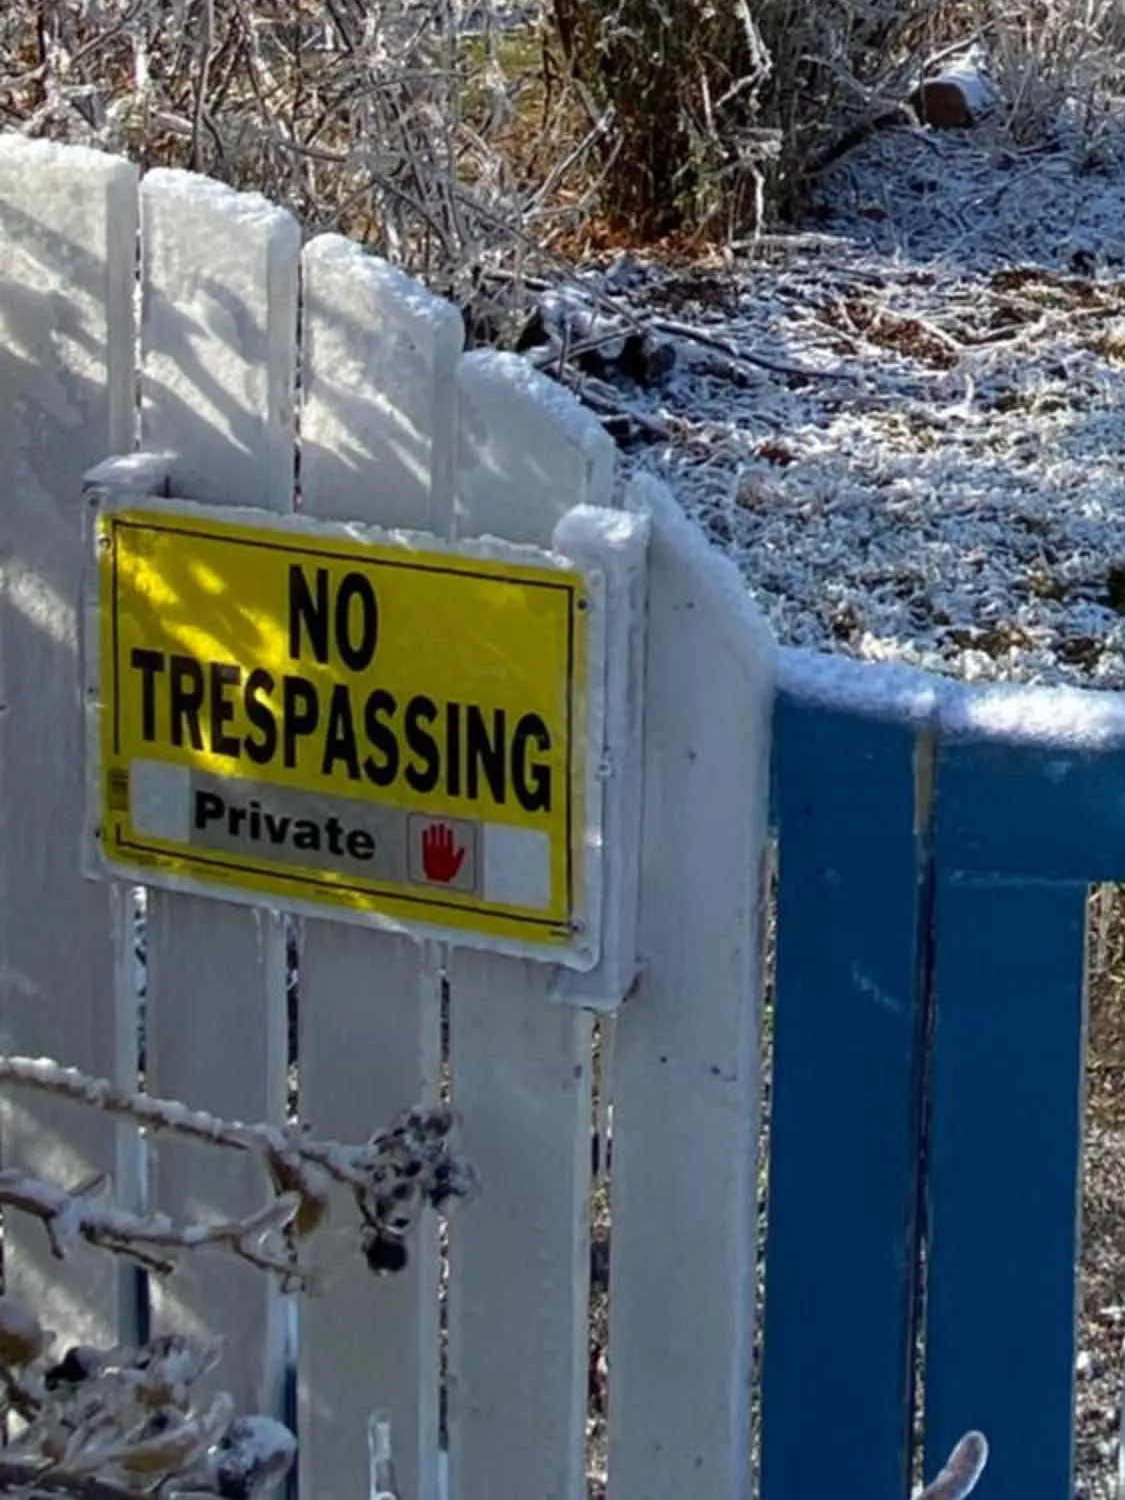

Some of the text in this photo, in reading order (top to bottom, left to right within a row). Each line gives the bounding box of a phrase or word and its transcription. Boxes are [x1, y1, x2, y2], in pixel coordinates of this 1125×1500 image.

[289, 564, 378, 671] NO
[131, 648, 552, 813] TRESPASSING
[195, 791, 375, 861] Private
